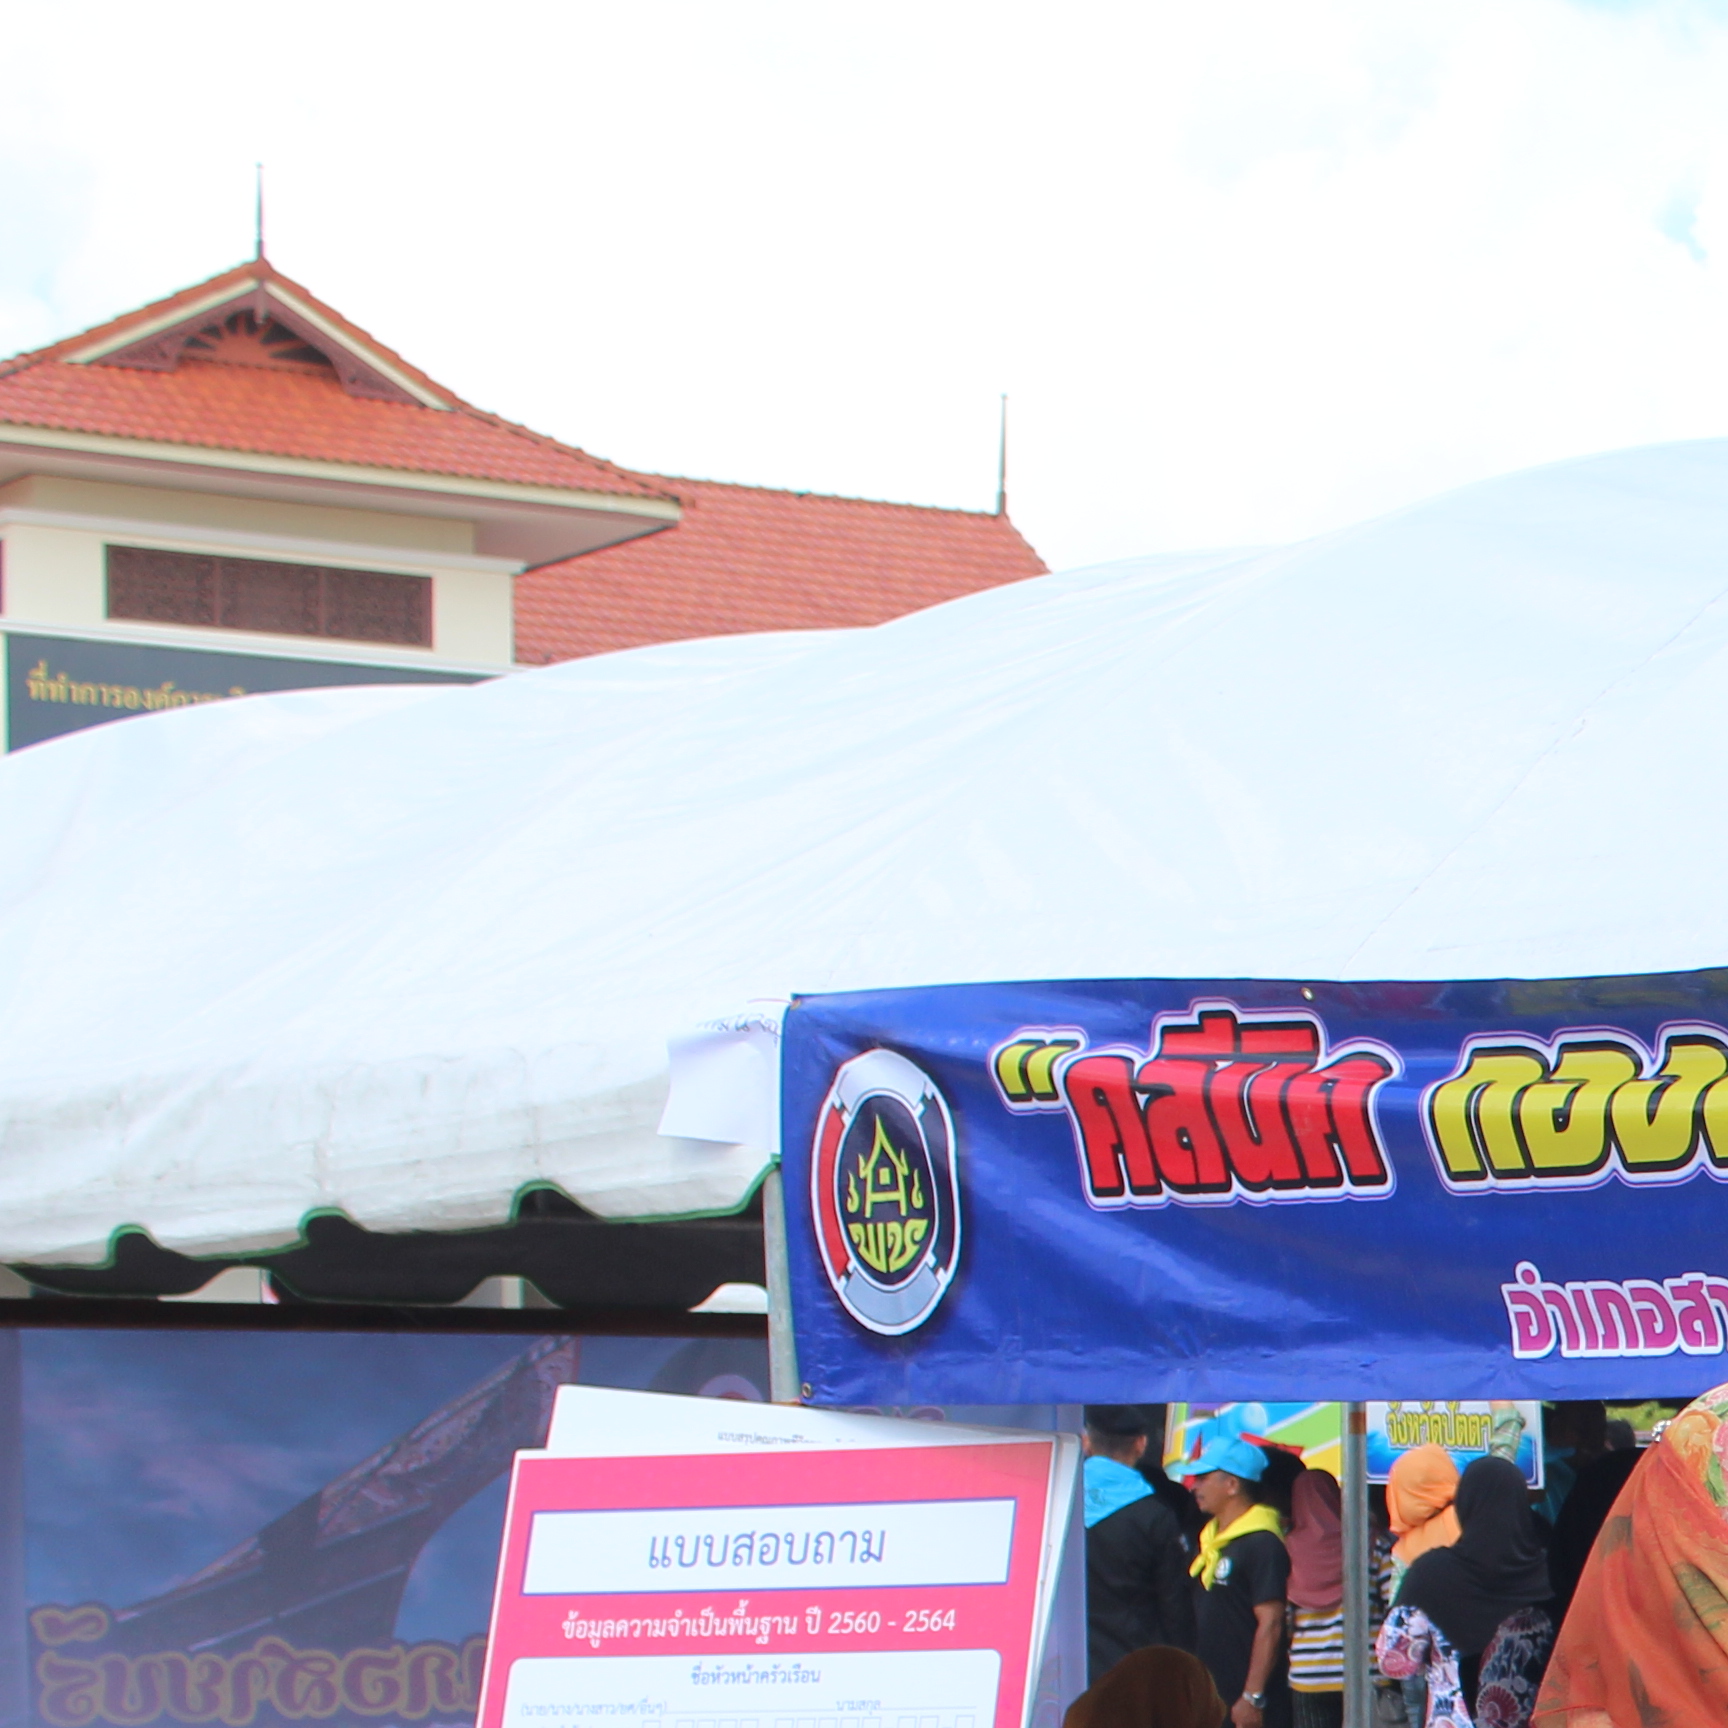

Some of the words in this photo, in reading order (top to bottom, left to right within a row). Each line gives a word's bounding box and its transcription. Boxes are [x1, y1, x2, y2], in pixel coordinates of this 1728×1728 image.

[648, 1528, 887, 1570] แบบสอบถาม
[562, 1600, 798, 1648] ข้อมูลความจำเป็นพื้นฐาน
[806, 1608, 822, 1635] ปี
[827, 1611, 880, 1634] 2560
[903, 1609, 956, 1633] 2564
[691, 1661, 822, 1686] ชื่อหัวหน้าครัวเรือน
[836, 1697, 882, 1714] นามสกุล
